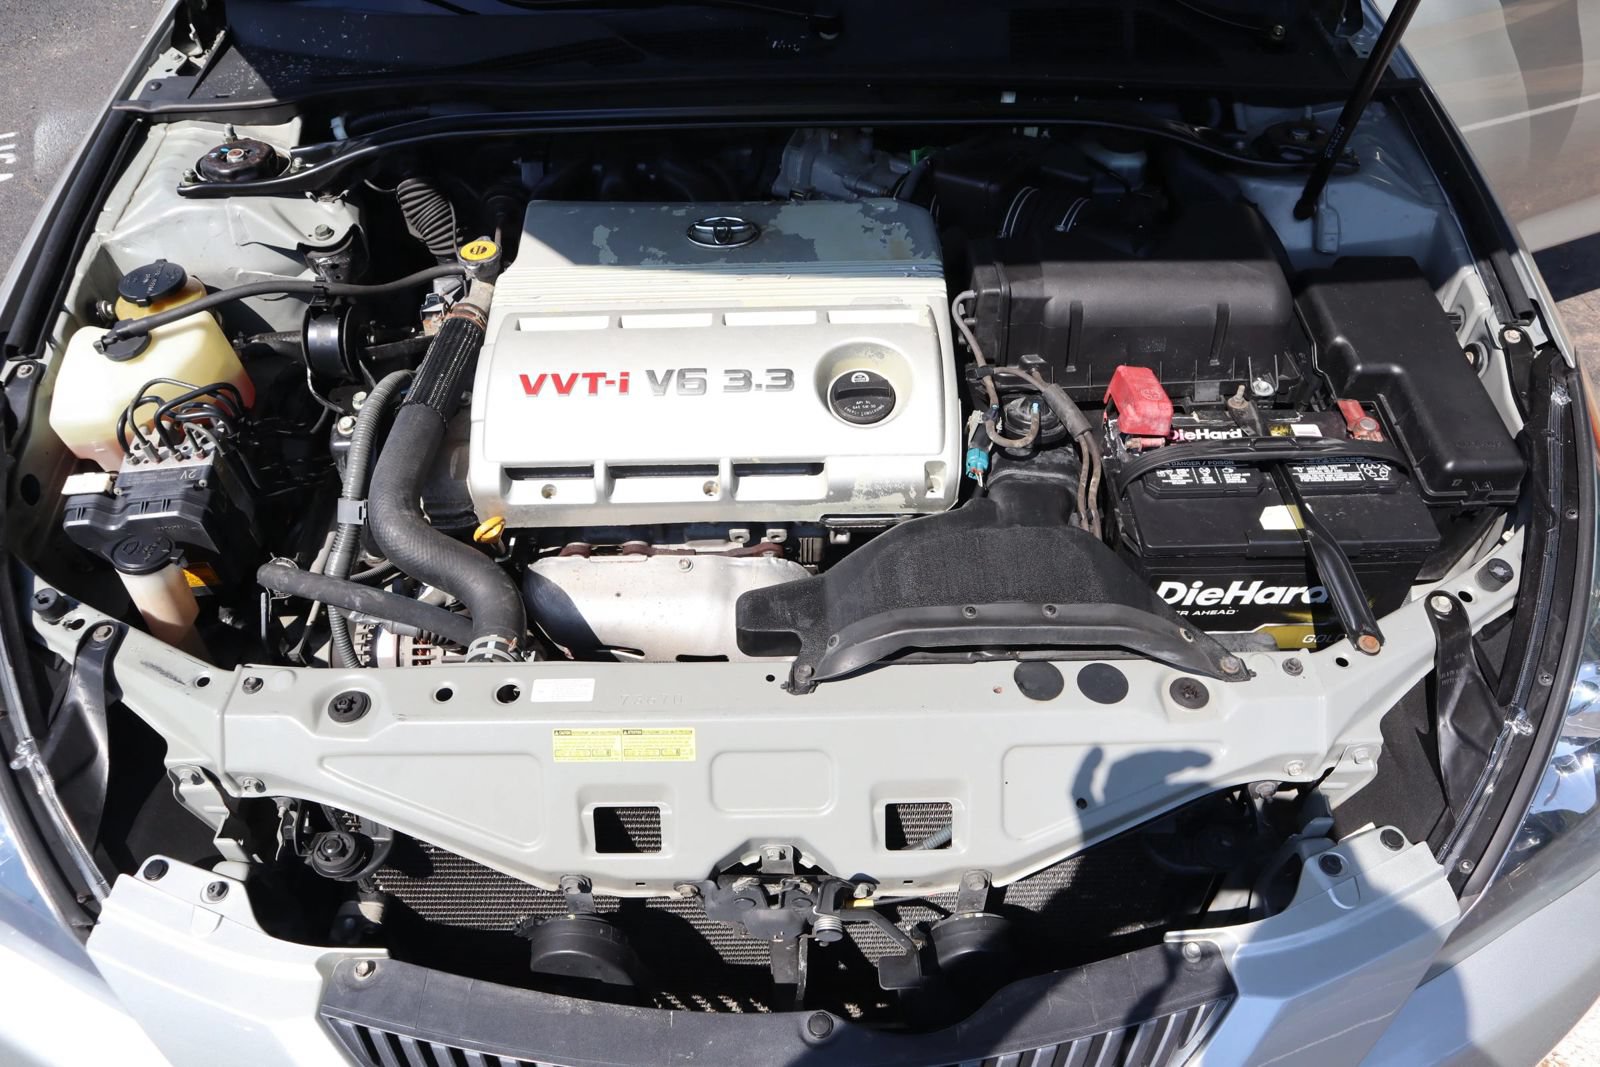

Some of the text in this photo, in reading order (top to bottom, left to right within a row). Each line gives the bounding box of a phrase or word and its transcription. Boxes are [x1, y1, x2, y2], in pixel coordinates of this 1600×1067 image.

[519, 368, 794, 397] VVT-i V6 3.3
[1169, 428, 1243, 441] DieHard
